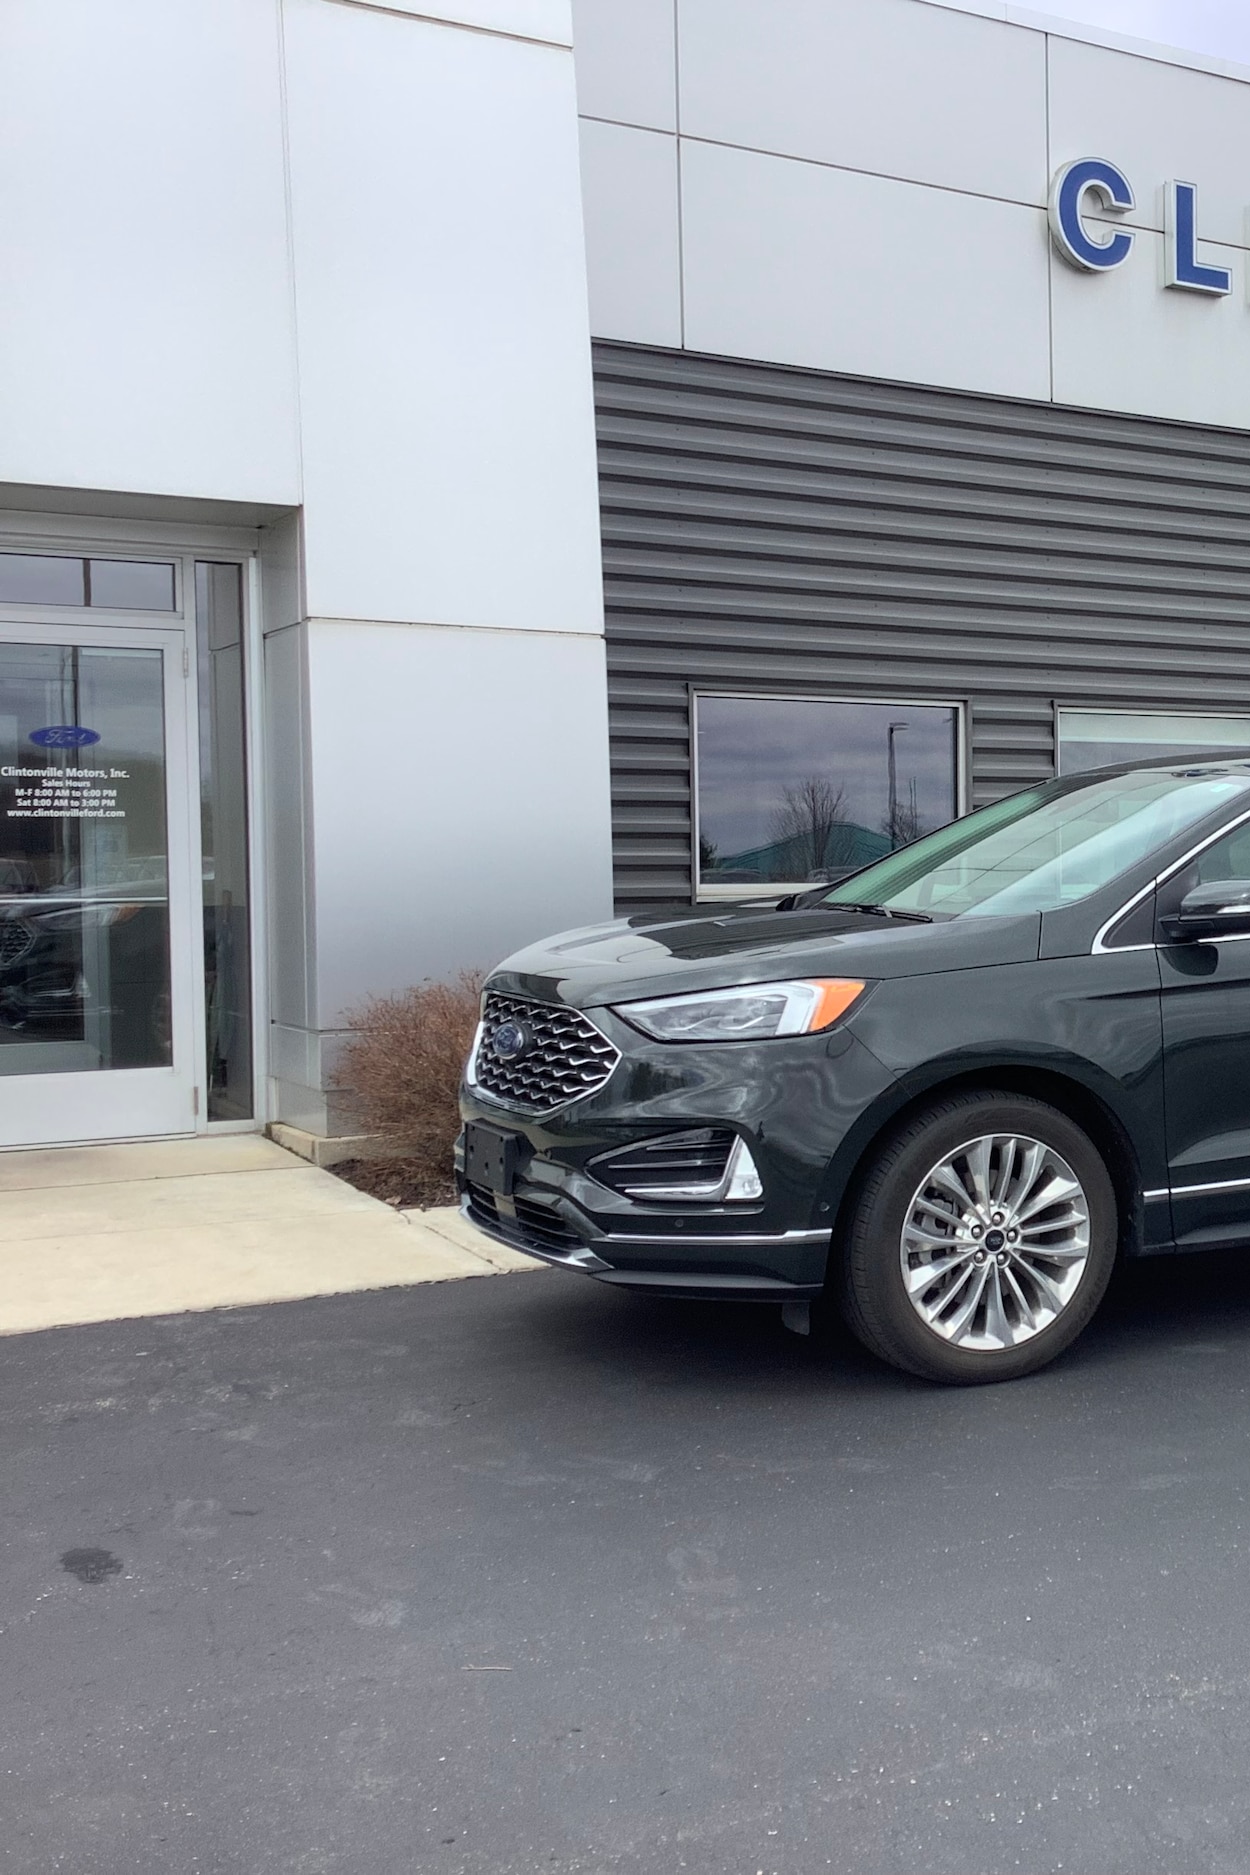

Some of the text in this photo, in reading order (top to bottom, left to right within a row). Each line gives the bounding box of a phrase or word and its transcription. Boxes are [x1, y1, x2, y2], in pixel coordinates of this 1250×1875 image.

[1, 766, 130, 779] Clintonville Motors, Inc.
[42, 779, 91, 788] Sales Hours
[15, 788, 117, 797] M-F 8:00 AM to 6:00 PM
[17, 798, 31, 807] Sat
[53, 798, 68, 807] AM
[70, 799, 80, 807] to
[81, 799, 100, 807] 3:00
[101, 799, 116, 807] PM
[7, 808, 126, 818] www.clintonvilleford.com
